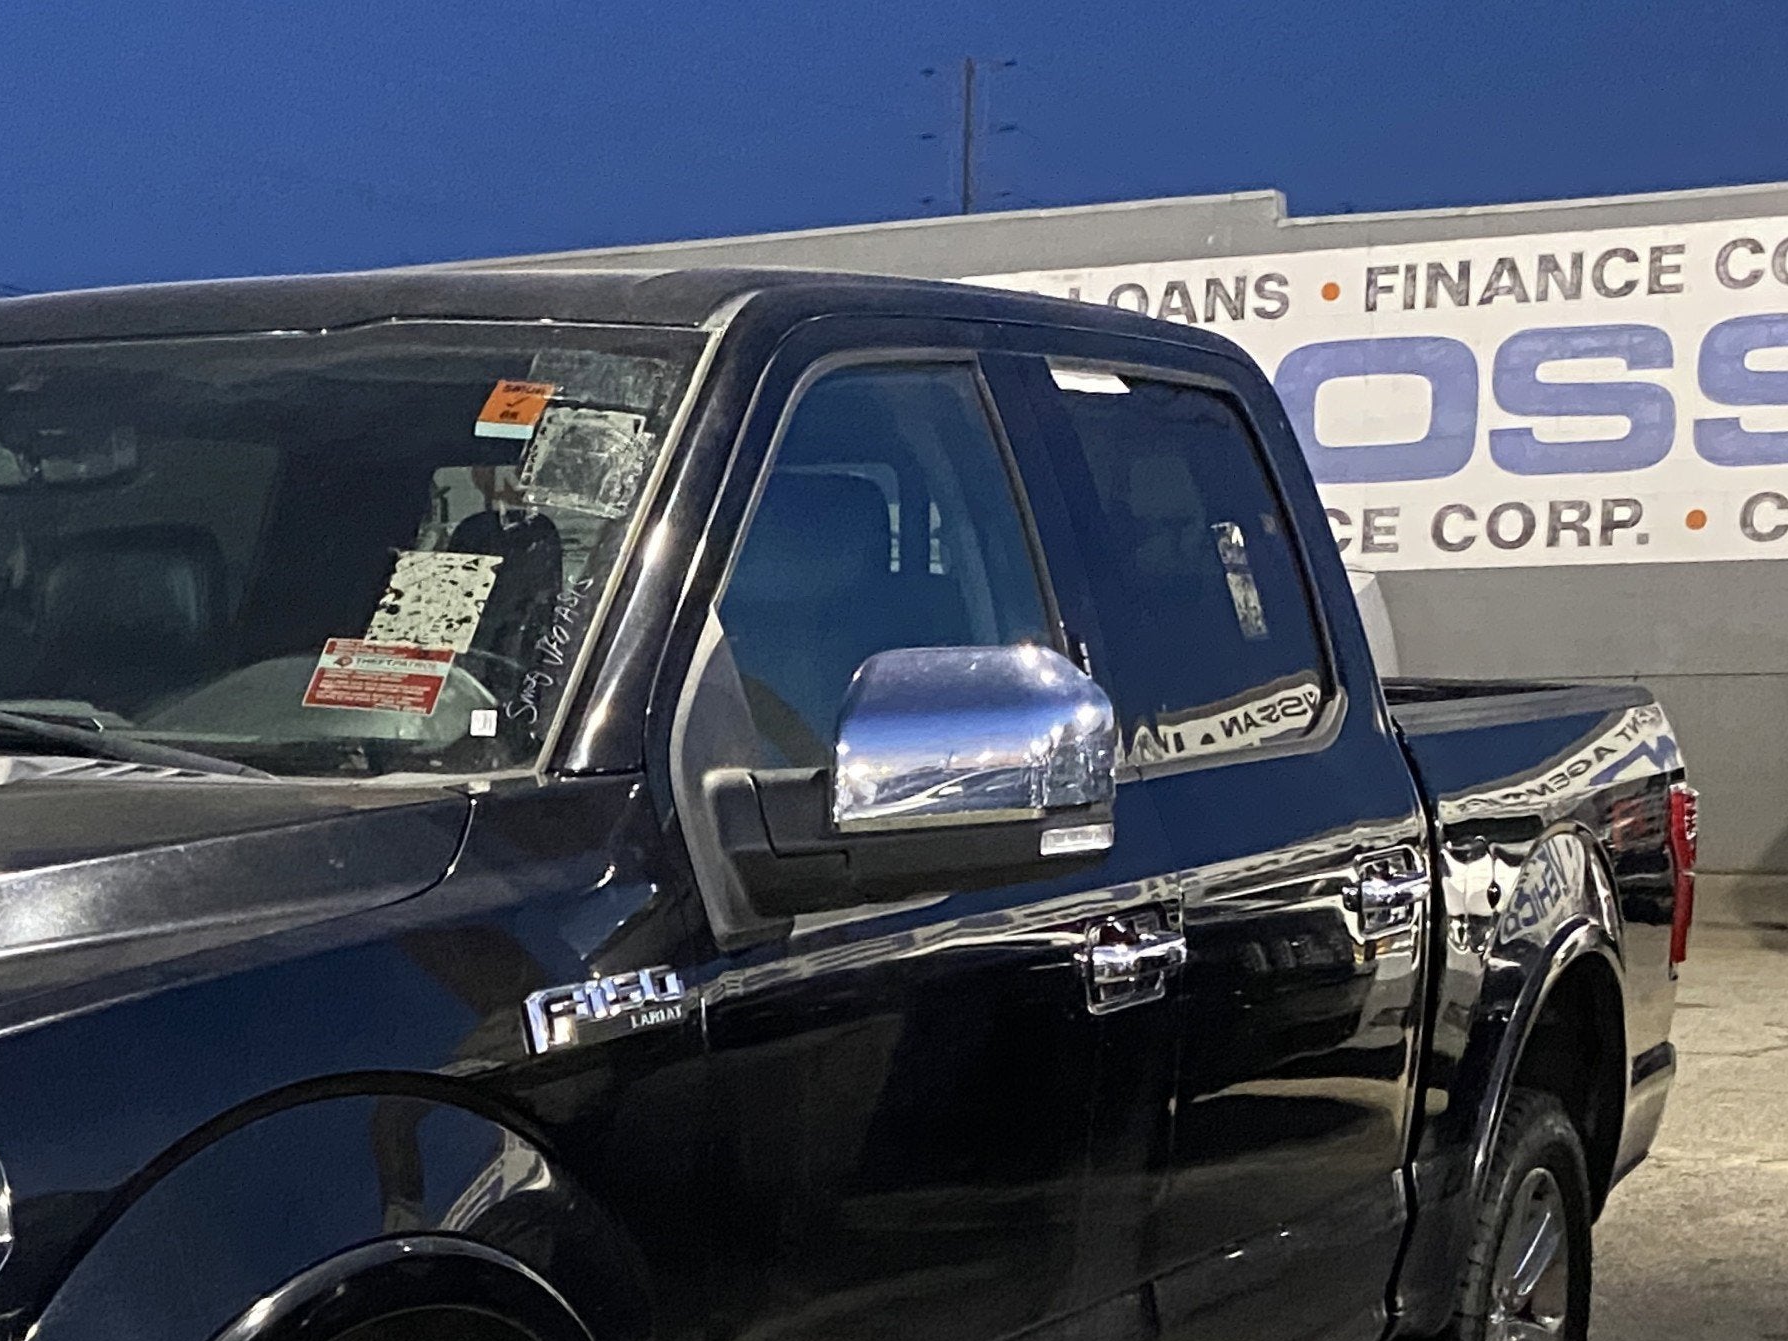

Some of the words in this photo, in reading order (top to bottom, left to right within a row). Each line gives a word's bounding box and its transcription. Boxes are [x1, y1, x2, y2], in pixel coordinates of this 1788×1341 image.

[1365, 243, 1686, 312] FINANCE
[1430, 497, 1650, 553] CORP.
[630, 1003, 683, 1029] LARIAT
